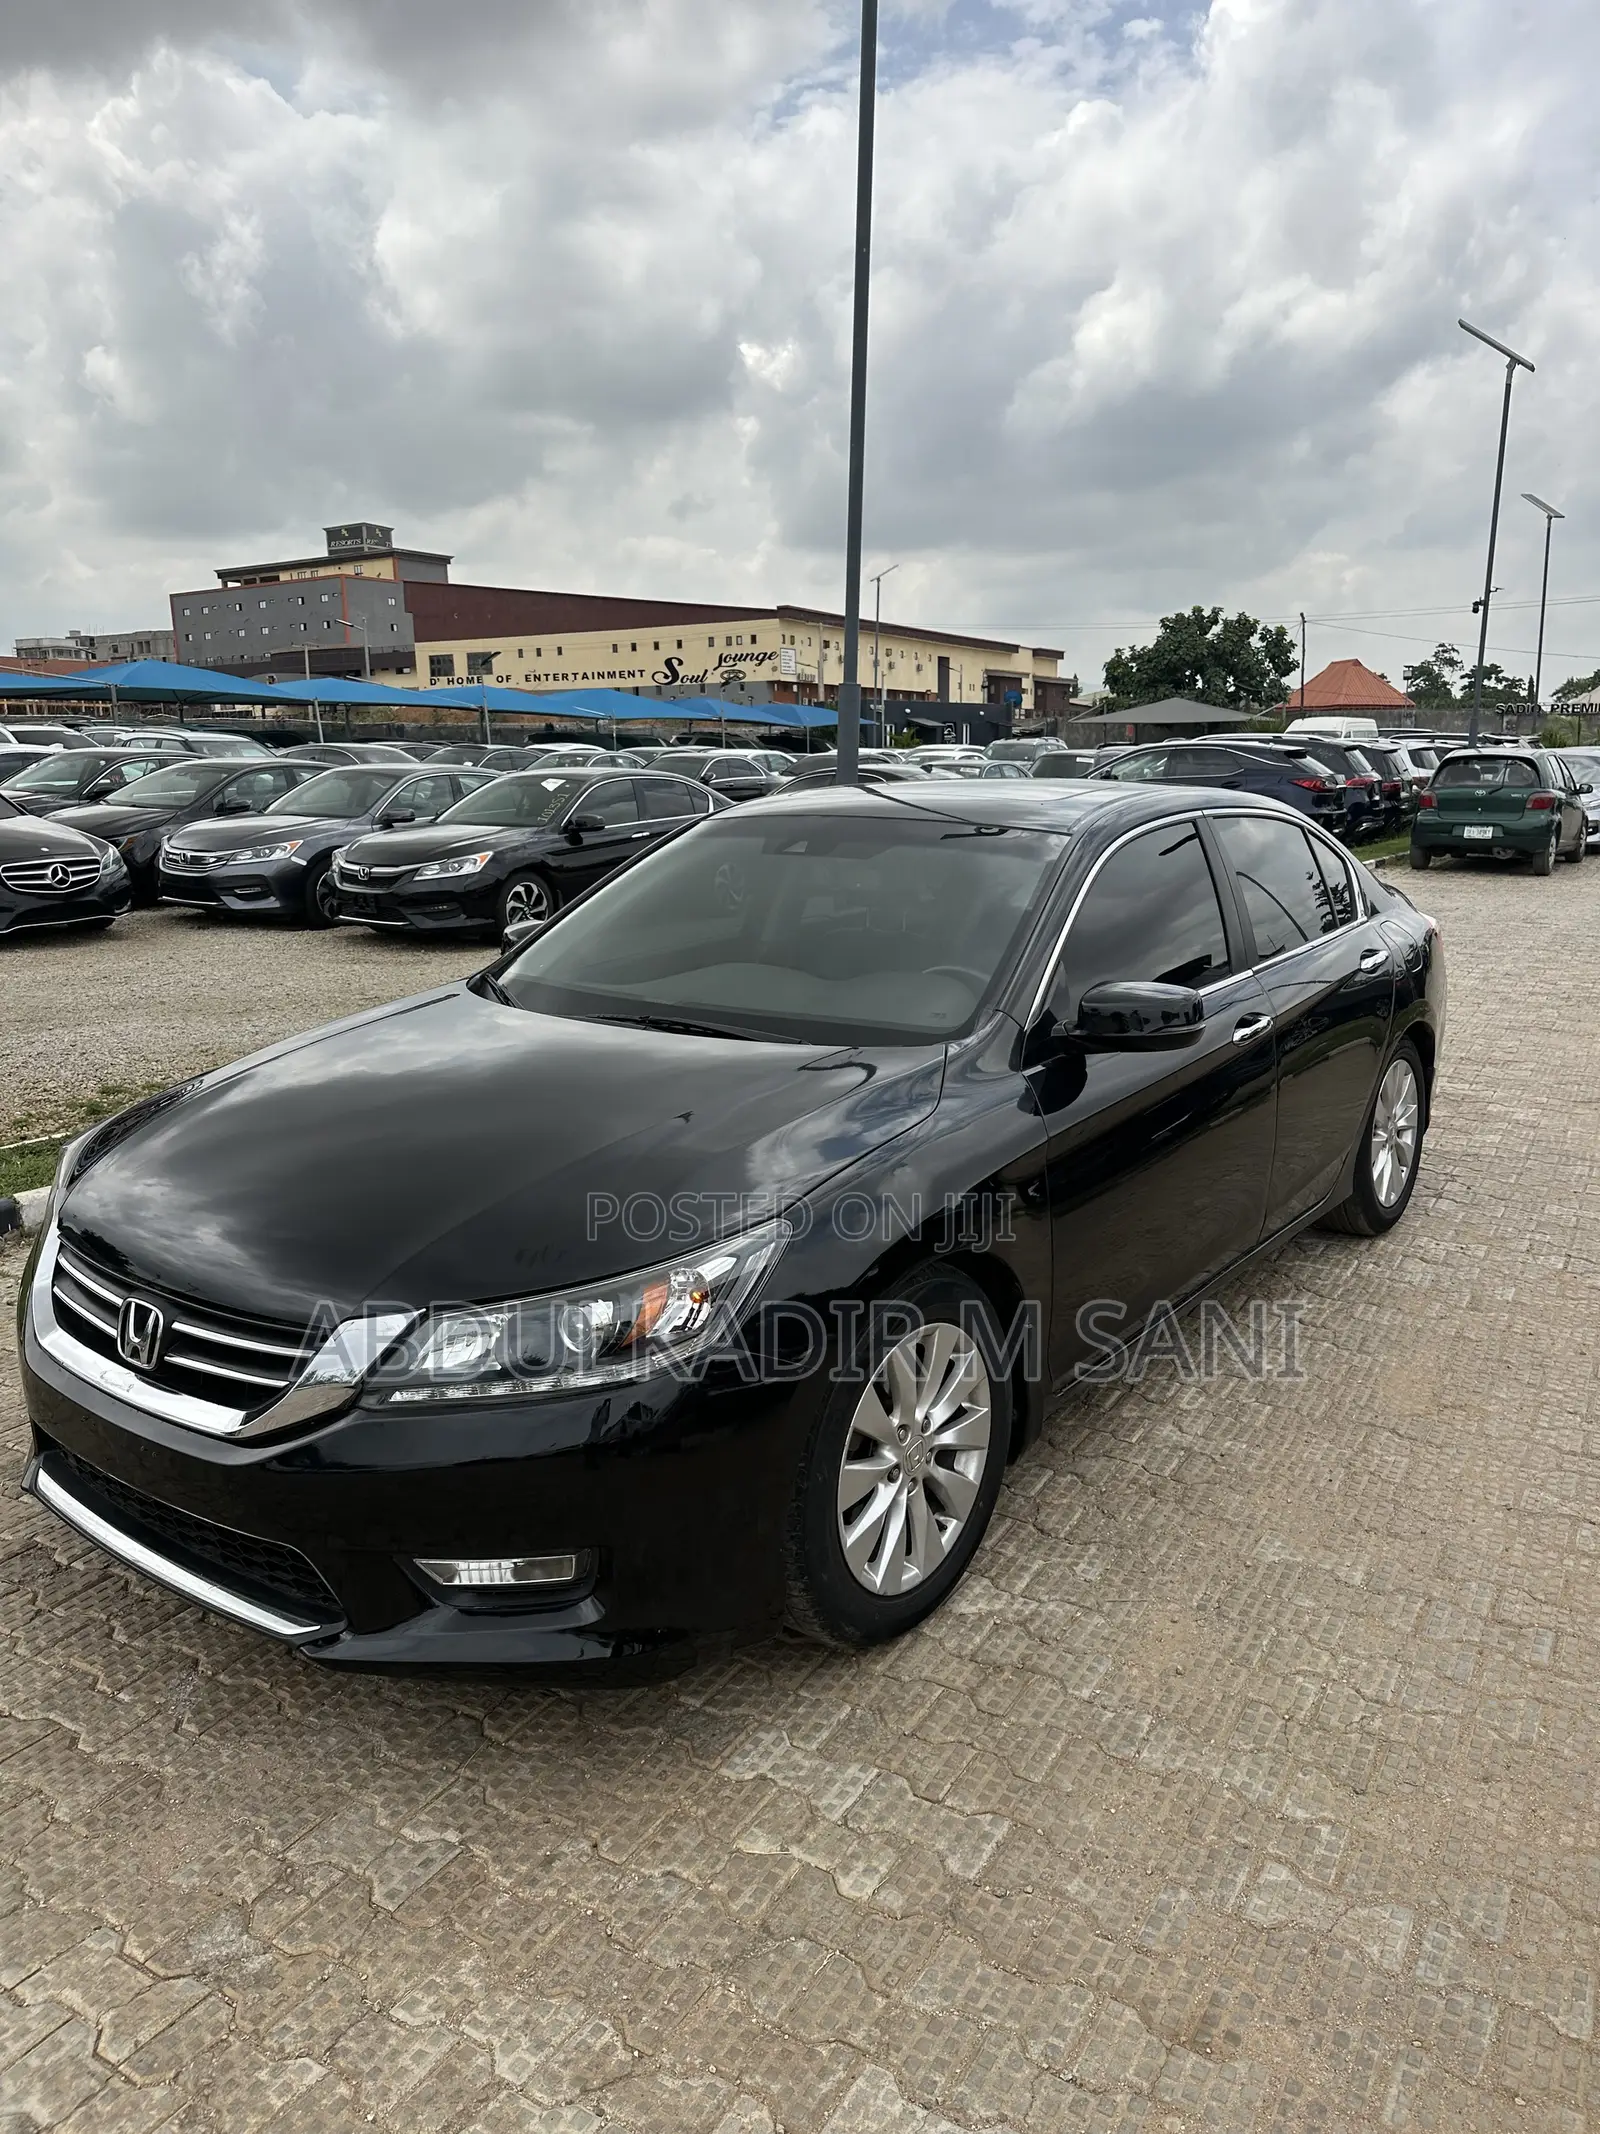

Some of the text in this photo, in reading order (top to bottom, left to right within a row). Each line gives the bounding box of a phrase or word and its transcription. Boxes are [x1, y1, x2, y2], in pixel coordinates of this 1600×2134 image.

[651, 656, 709, 686] Soul
[713, 650, 780, 671] Lounge
[447, 675, 483, 685] HOME
[496, 674, 512, 684] OF
[524, 669, 646, 683] ENTERTAINMENT
[1550, 702, 1600, 714] PREMI
